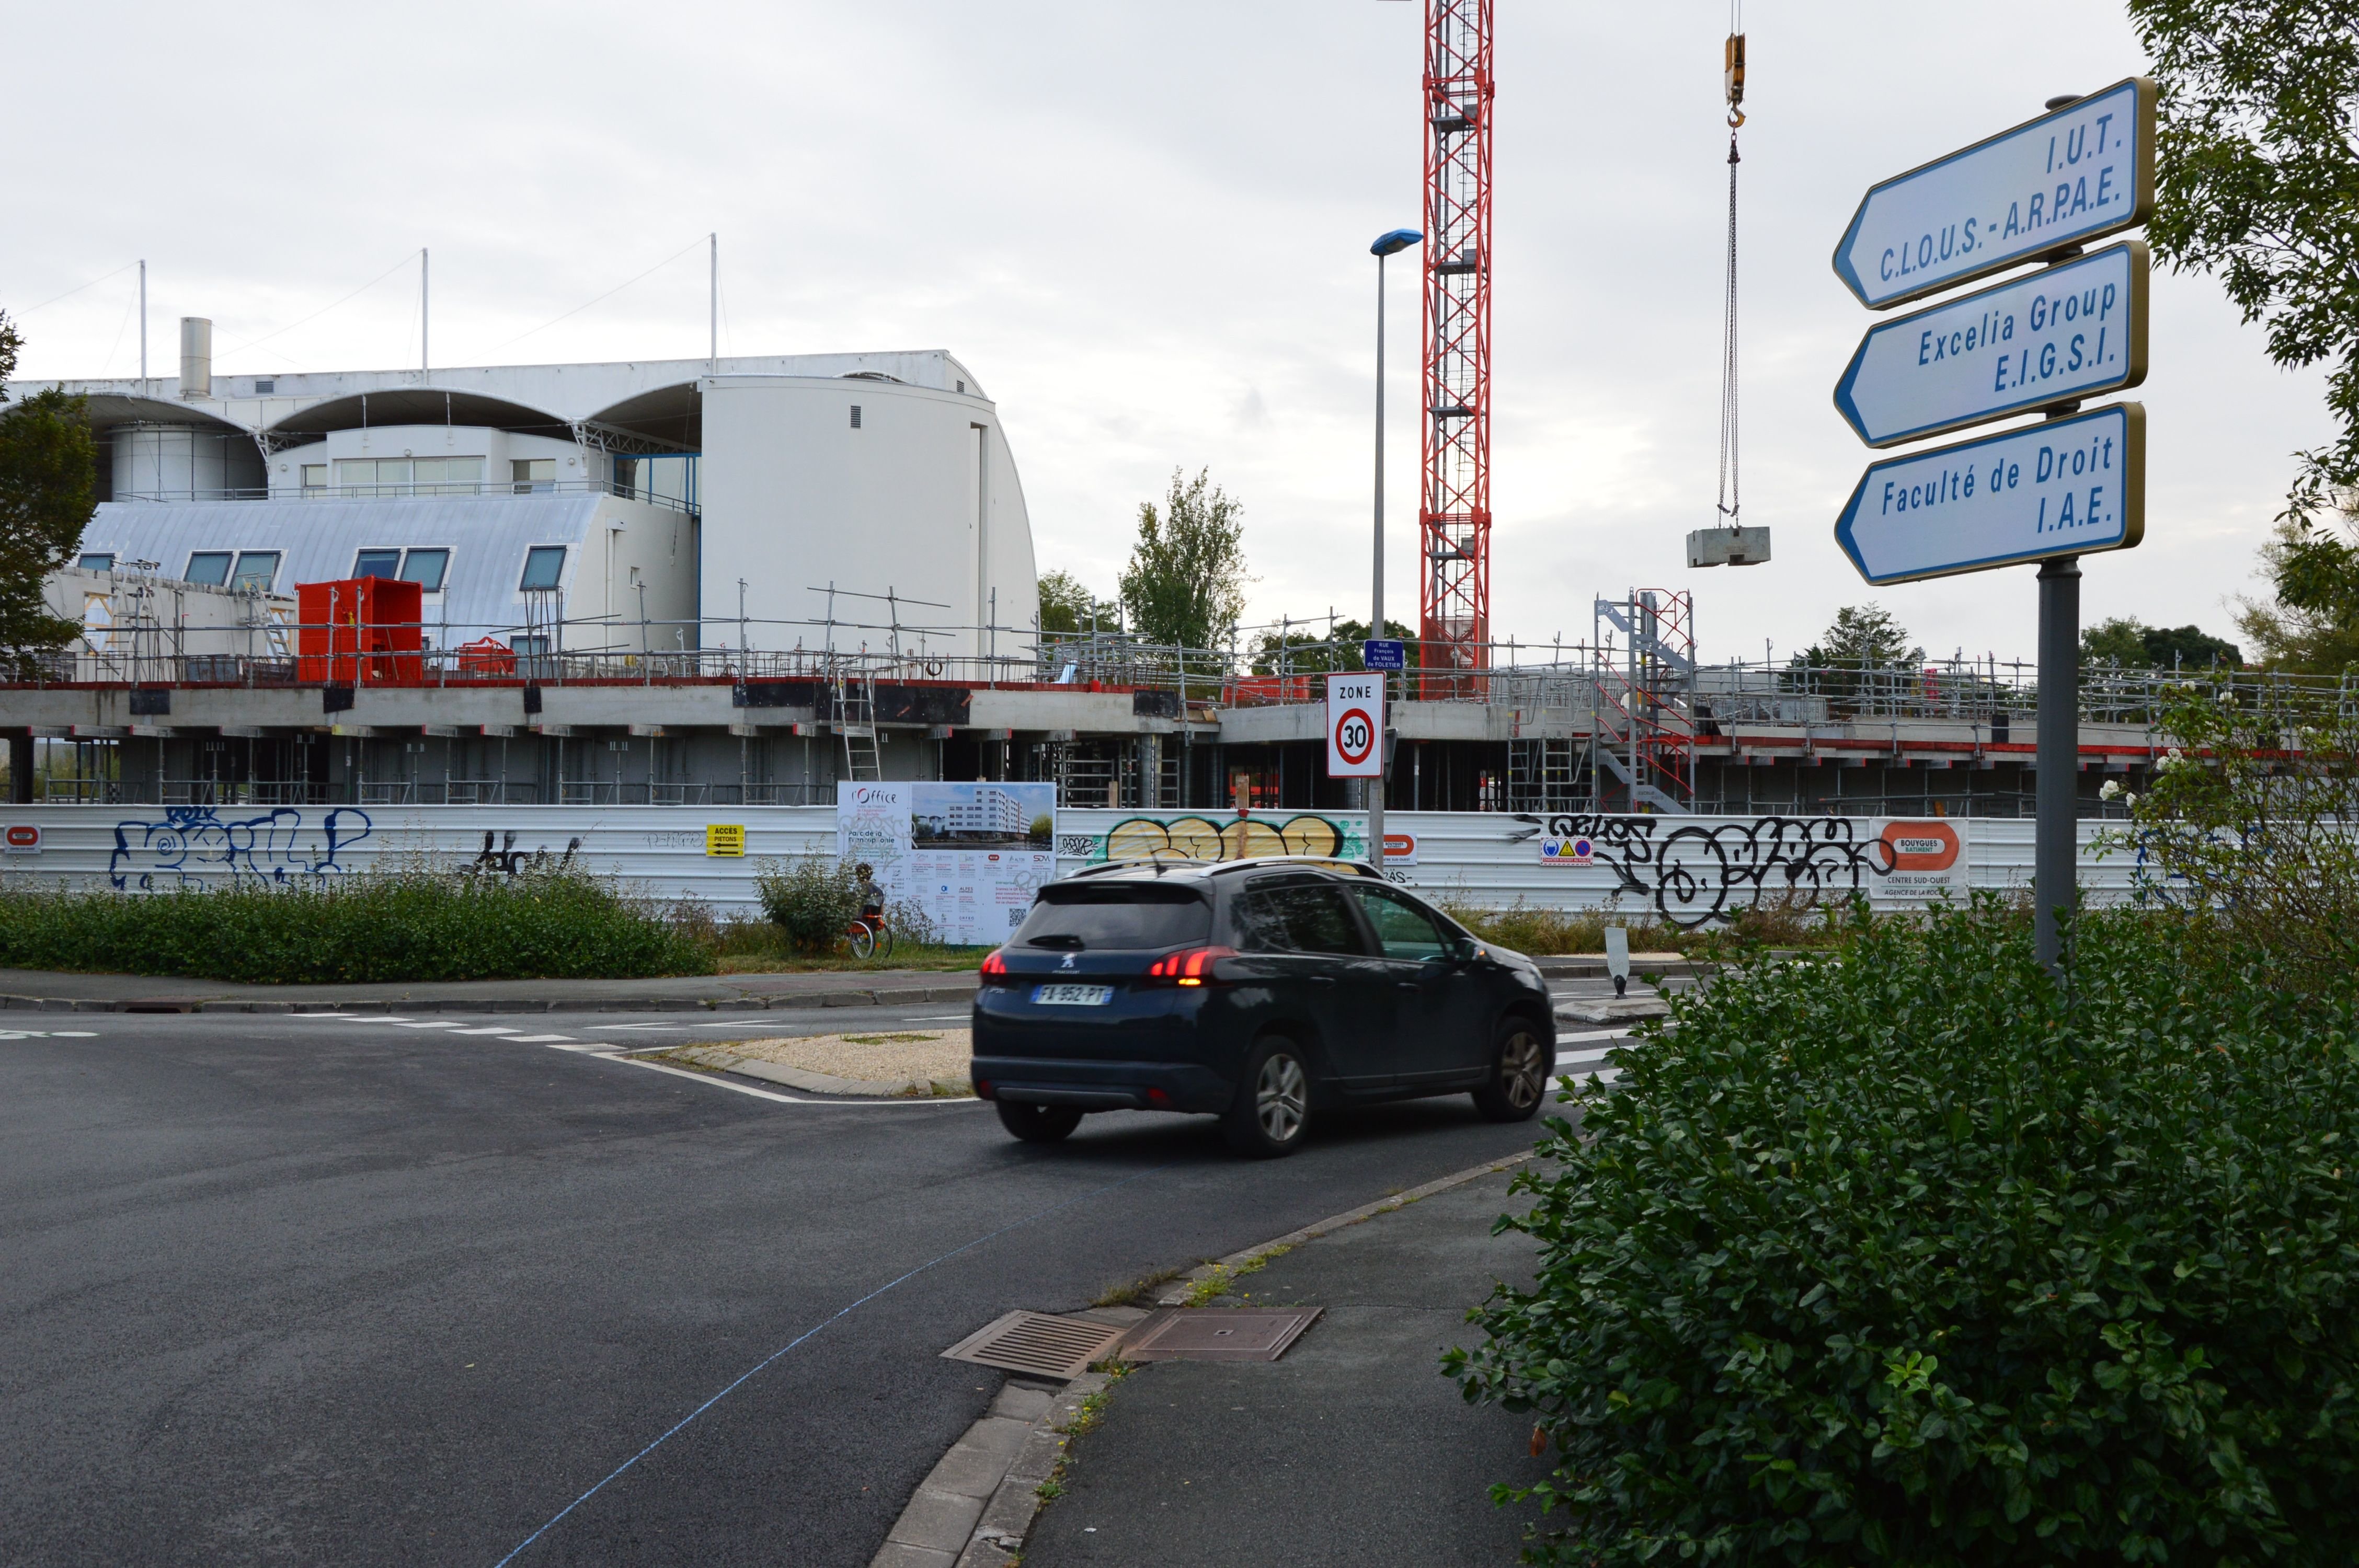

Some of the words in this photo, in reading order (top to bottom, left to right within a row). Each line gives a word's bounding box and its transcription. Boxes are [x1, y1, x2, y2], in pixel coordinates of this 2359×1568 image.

[2047, 113, 2121, 174] I.U.T.
[1919, 313, 2013, 365] Excelia
[2031, 282, 2115, 332] Group
[1995, 328, 2114, 391] E.I.G.S.I.
[1883, 465, 1975, 514] Faculté
[1991, 457, 2020, 493] de
[2036, 437, 2112, 483] Droit
[2038, 486, 2111, 533] I.A.E.
[1340, 686, 1371, 699] ZONE
[1344, 725, 1366, 748] 30
